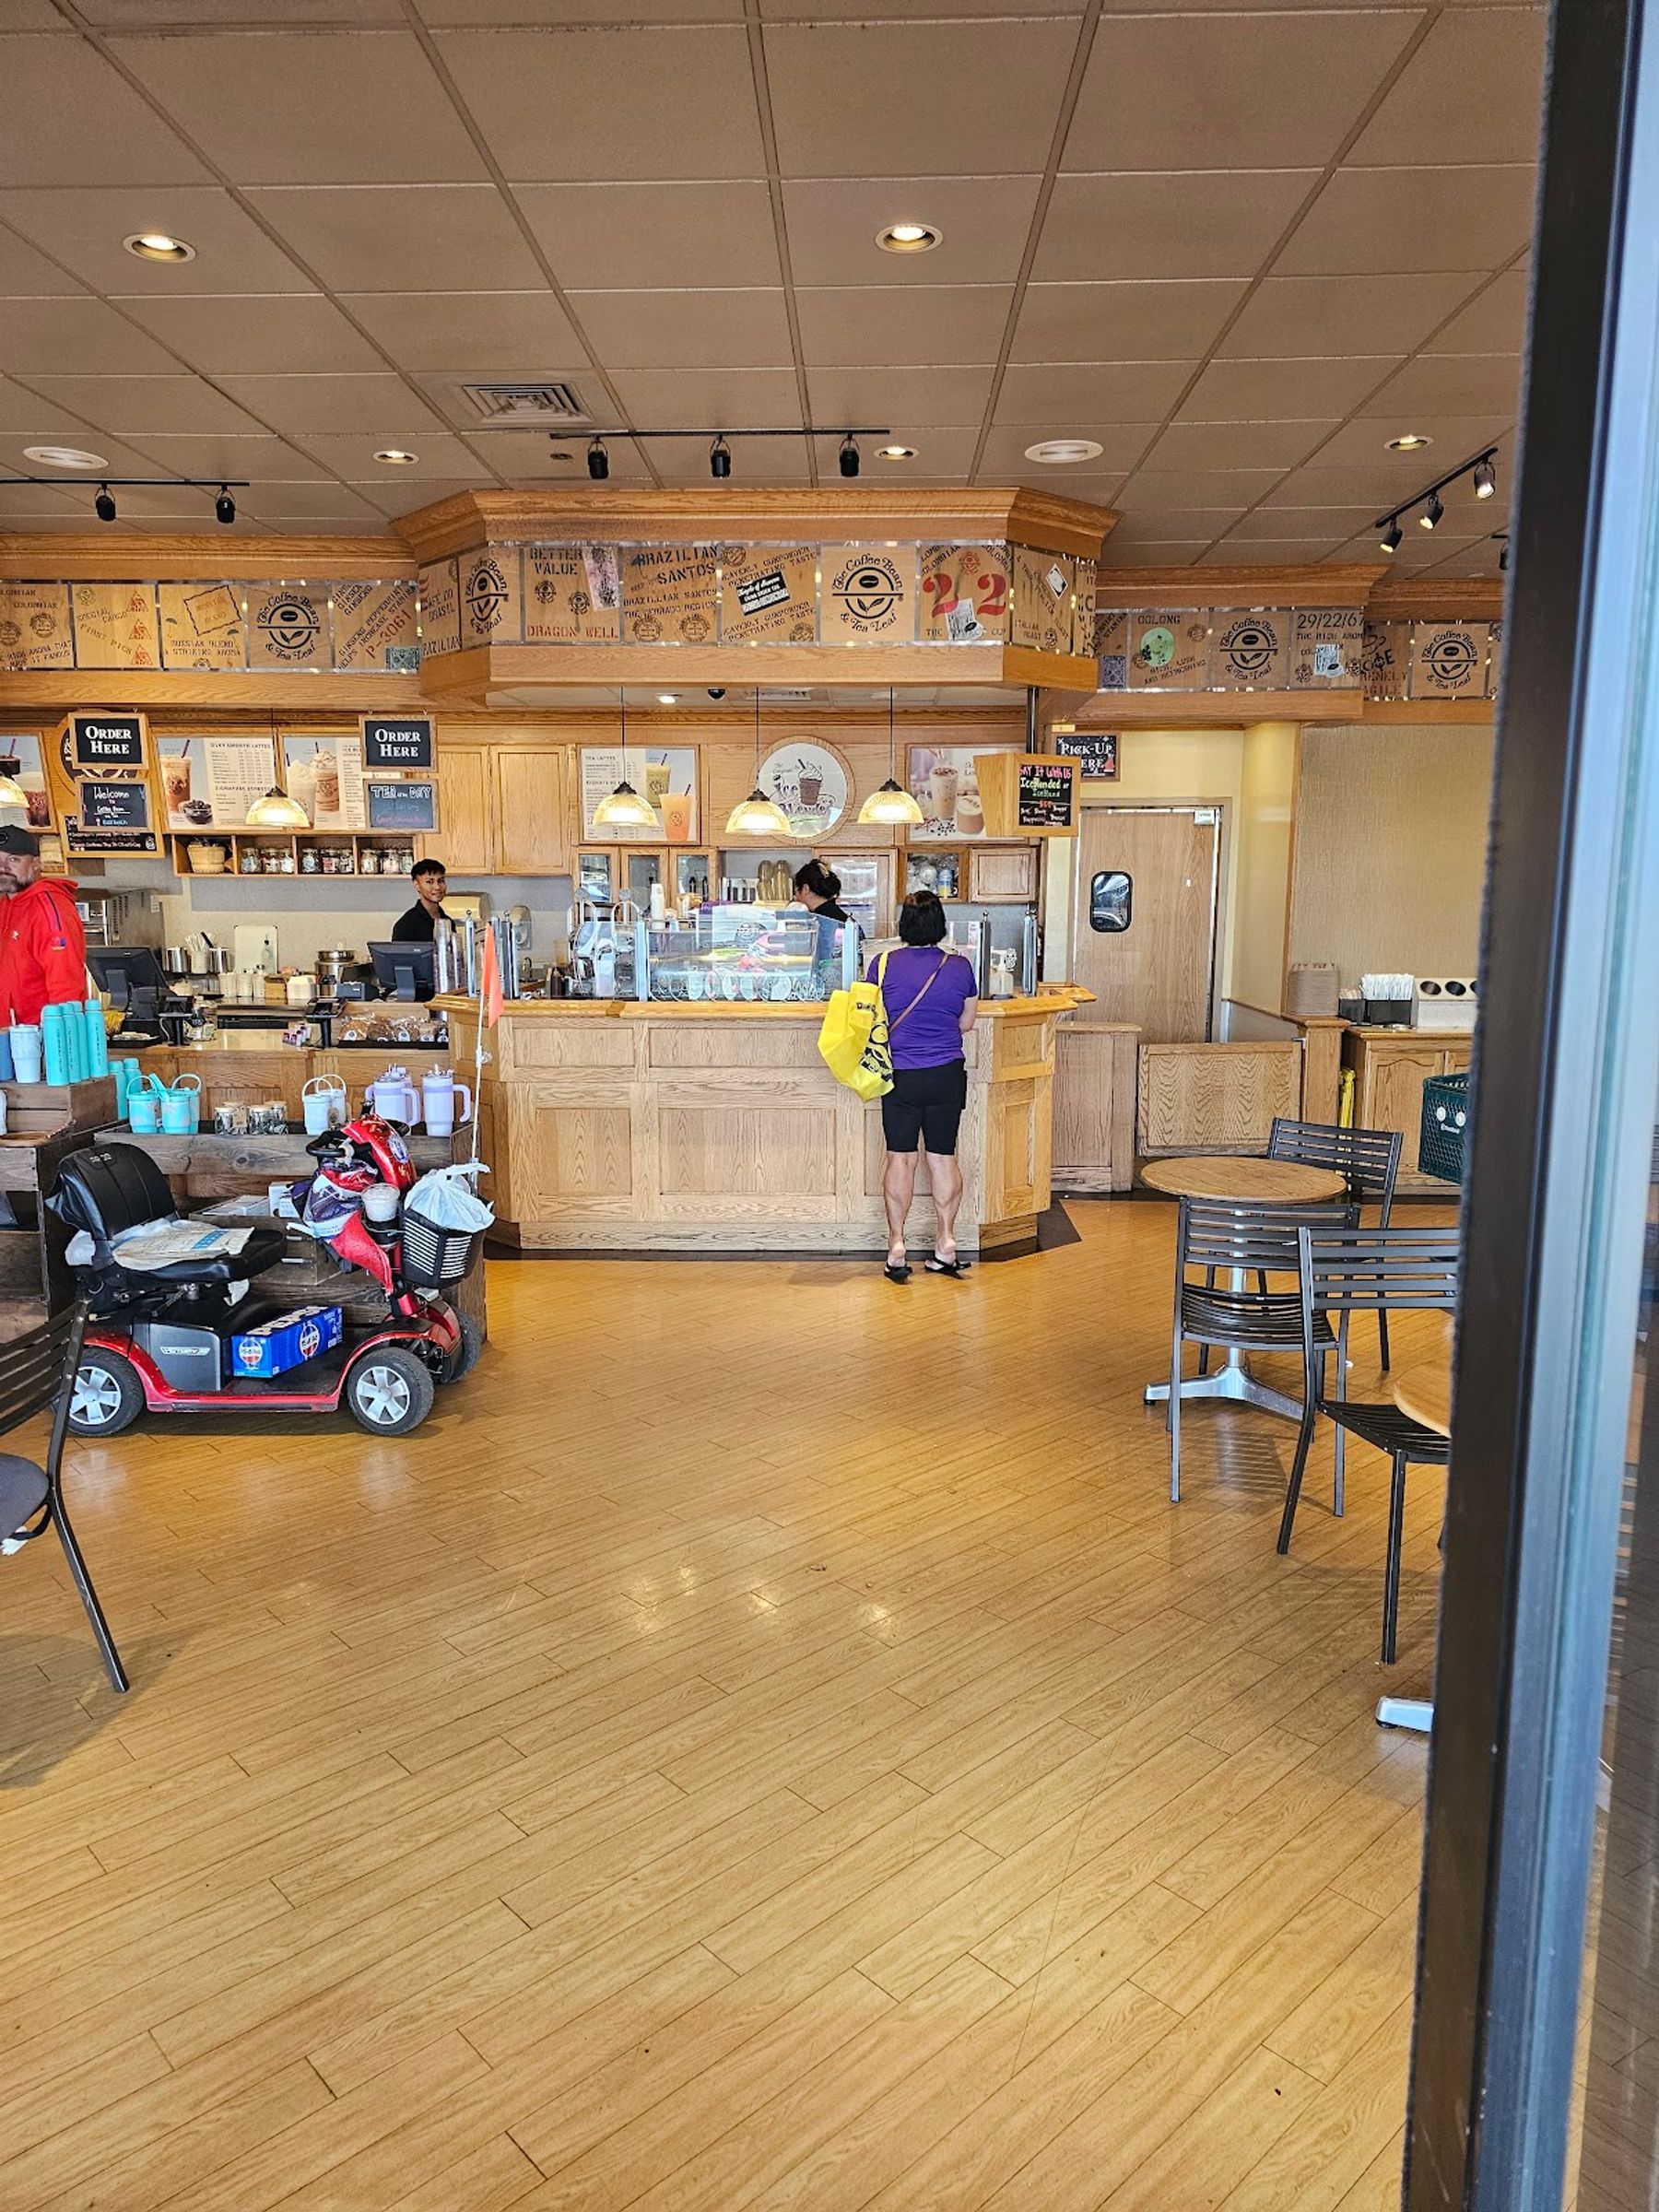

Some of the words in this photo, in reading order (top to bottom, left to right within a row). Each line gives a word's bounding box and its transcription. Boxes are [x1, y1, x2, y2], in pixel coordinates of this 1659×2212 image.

[636, 546, 717, 566] BRAZILIAN
[535, 562, 578, 575] VALUE
[657, 562, 716, 584] SANTOS
[832, 570, 845, 591] The
[845, 554, 881, 572] Coffee
[882, 557, 904, 592] Bean
[257, 607, 271, 624] The
[267, 591, 299, 607] Coffee
[300, 594, 320, 625] Bean
[850, 618, 868, 633] Tea
[870, 608, 898, 633] Leaf
[1137, 614, 1181, 625] OOLONG
[527, 625, 577, 638] DRAGON
[585, 626, 619, 639] WELL
[1220, 628, 1233, 648] The
[1232, 616, 1262, 631] Coffee
[1262, 619, 1279, 648] Bean
[276, 647, 292, 661] Tea
[292, 640, 316, 661] Leaf
[1433, 629, 1462, 642] Coffee
[1462, 633, 1478, 659] Bean
[1234, 670, 1249, 680] Tea
[1250, 660, 1273, 680] Leaf
[85, 725, 133, 740] ORDER
[374, 728, 422, 743] ORDER
[90, 740, 130, 755] HERE
[380, 744, 418, 758] HERE
[1080, 759, 1105, 769] ERE
[93, 786, 130, 799] Welcome
